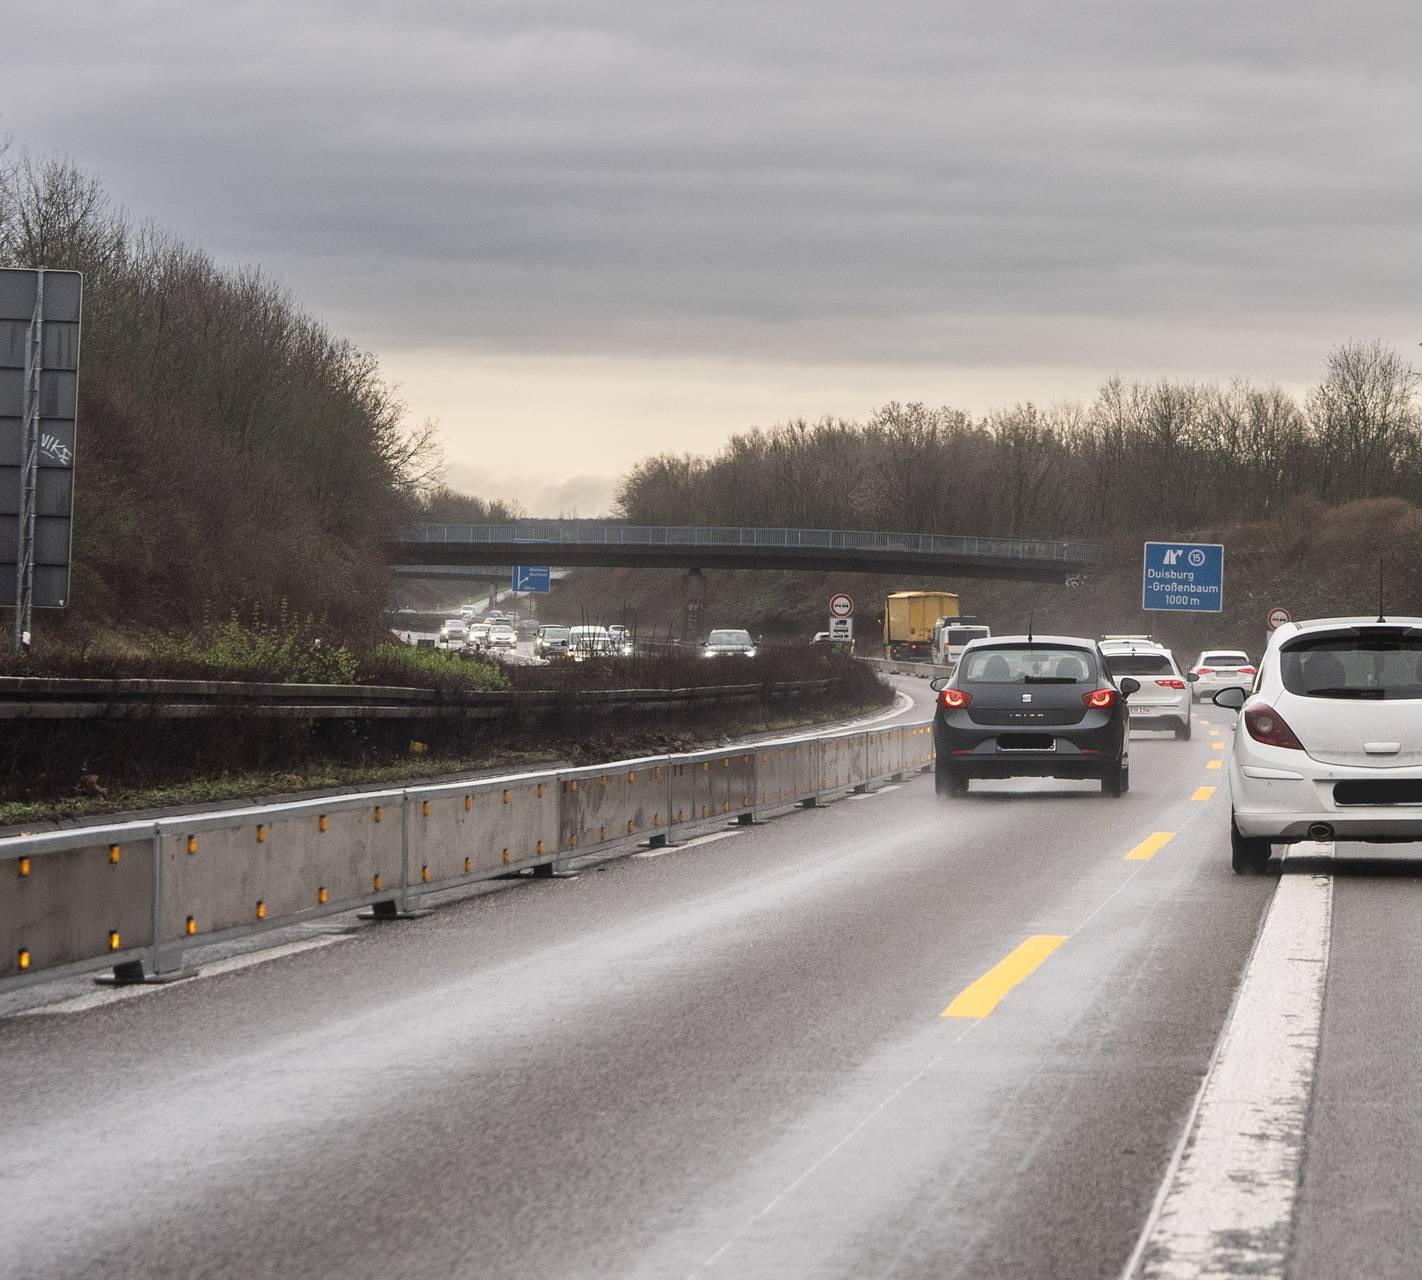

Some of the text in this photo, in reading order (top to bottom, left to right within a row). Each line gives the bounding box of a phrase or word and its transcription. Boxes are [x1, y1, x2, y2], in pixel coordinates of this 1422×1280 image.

[1192, 553, 1201, 562] 15
[1148, 569, 1194, 581] Duisburg
[1148, 582, 1218, 593] -Großenbaum
[1166, 595, 1200, 606] 1000 m
